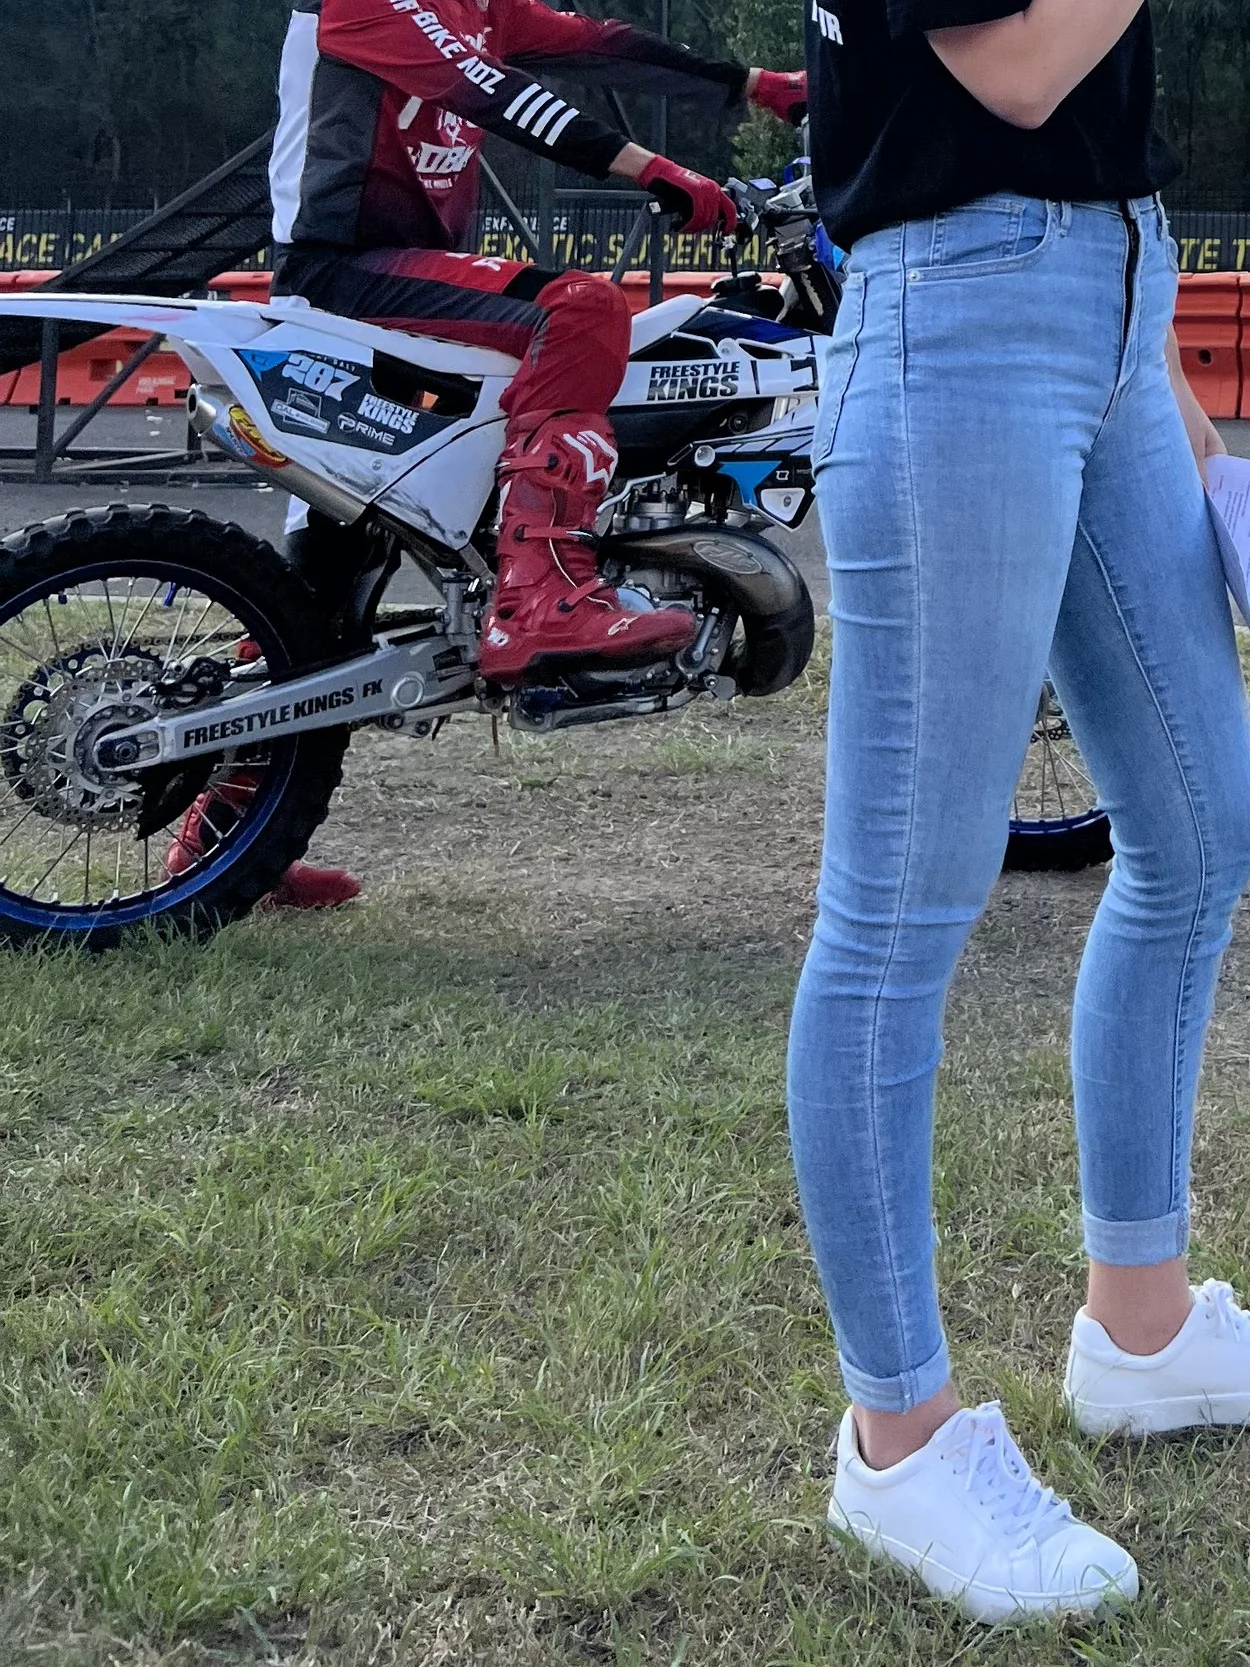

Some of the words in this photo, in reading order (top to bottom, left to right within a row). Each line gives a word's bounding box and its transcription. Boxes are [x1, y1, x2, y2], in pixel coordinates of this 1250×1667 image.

[411, 11, 468, 60] BIKE
[0, 233, 57, 264] ACE
[1179, 238, 1221, 270] TE
[281, 352, 361, 402] 287
[650, 361, 740, 379] FREESTYLE
[646, 374, 739, 402] KINGS
[357, 404, 416, 435] KINGS
[361, 393, 420, 421] FREESTYLE
[337, 413, 396, 446] PRIME
[183, 704, 290, 749] FREESTYLE
[293, 686, 355, 721] KINGS
[362, 678, 384, 699] FK
